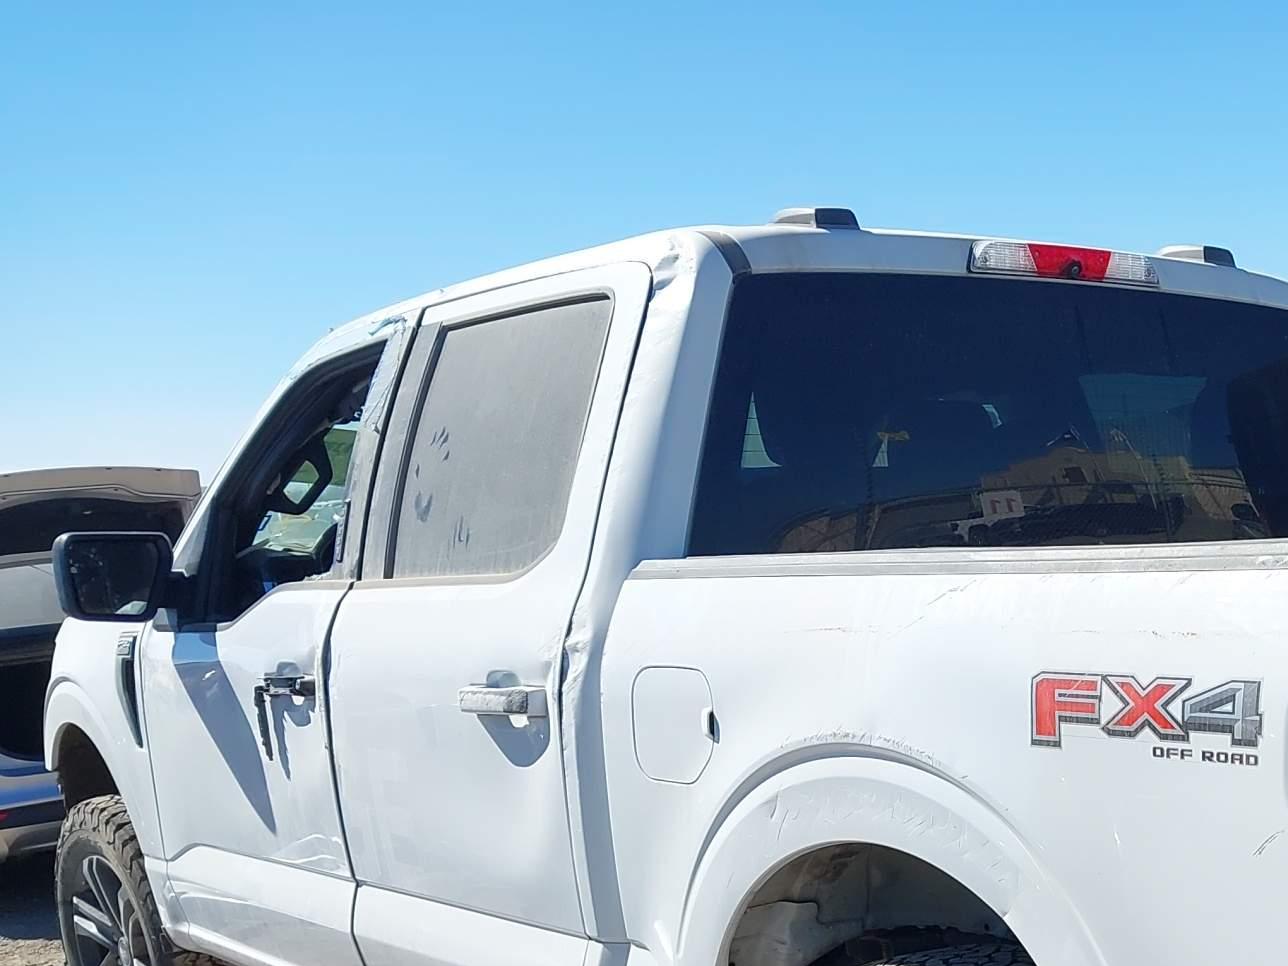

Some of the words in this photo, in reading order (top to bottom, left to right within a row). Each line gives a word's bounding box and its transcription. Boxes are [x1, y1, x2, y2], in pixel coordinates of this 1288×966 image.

[1030, 671, 1263, 748] FX4
[1152, 746, 1193, 760] OFF
[1201, 750, 1259, 766] ROAD
